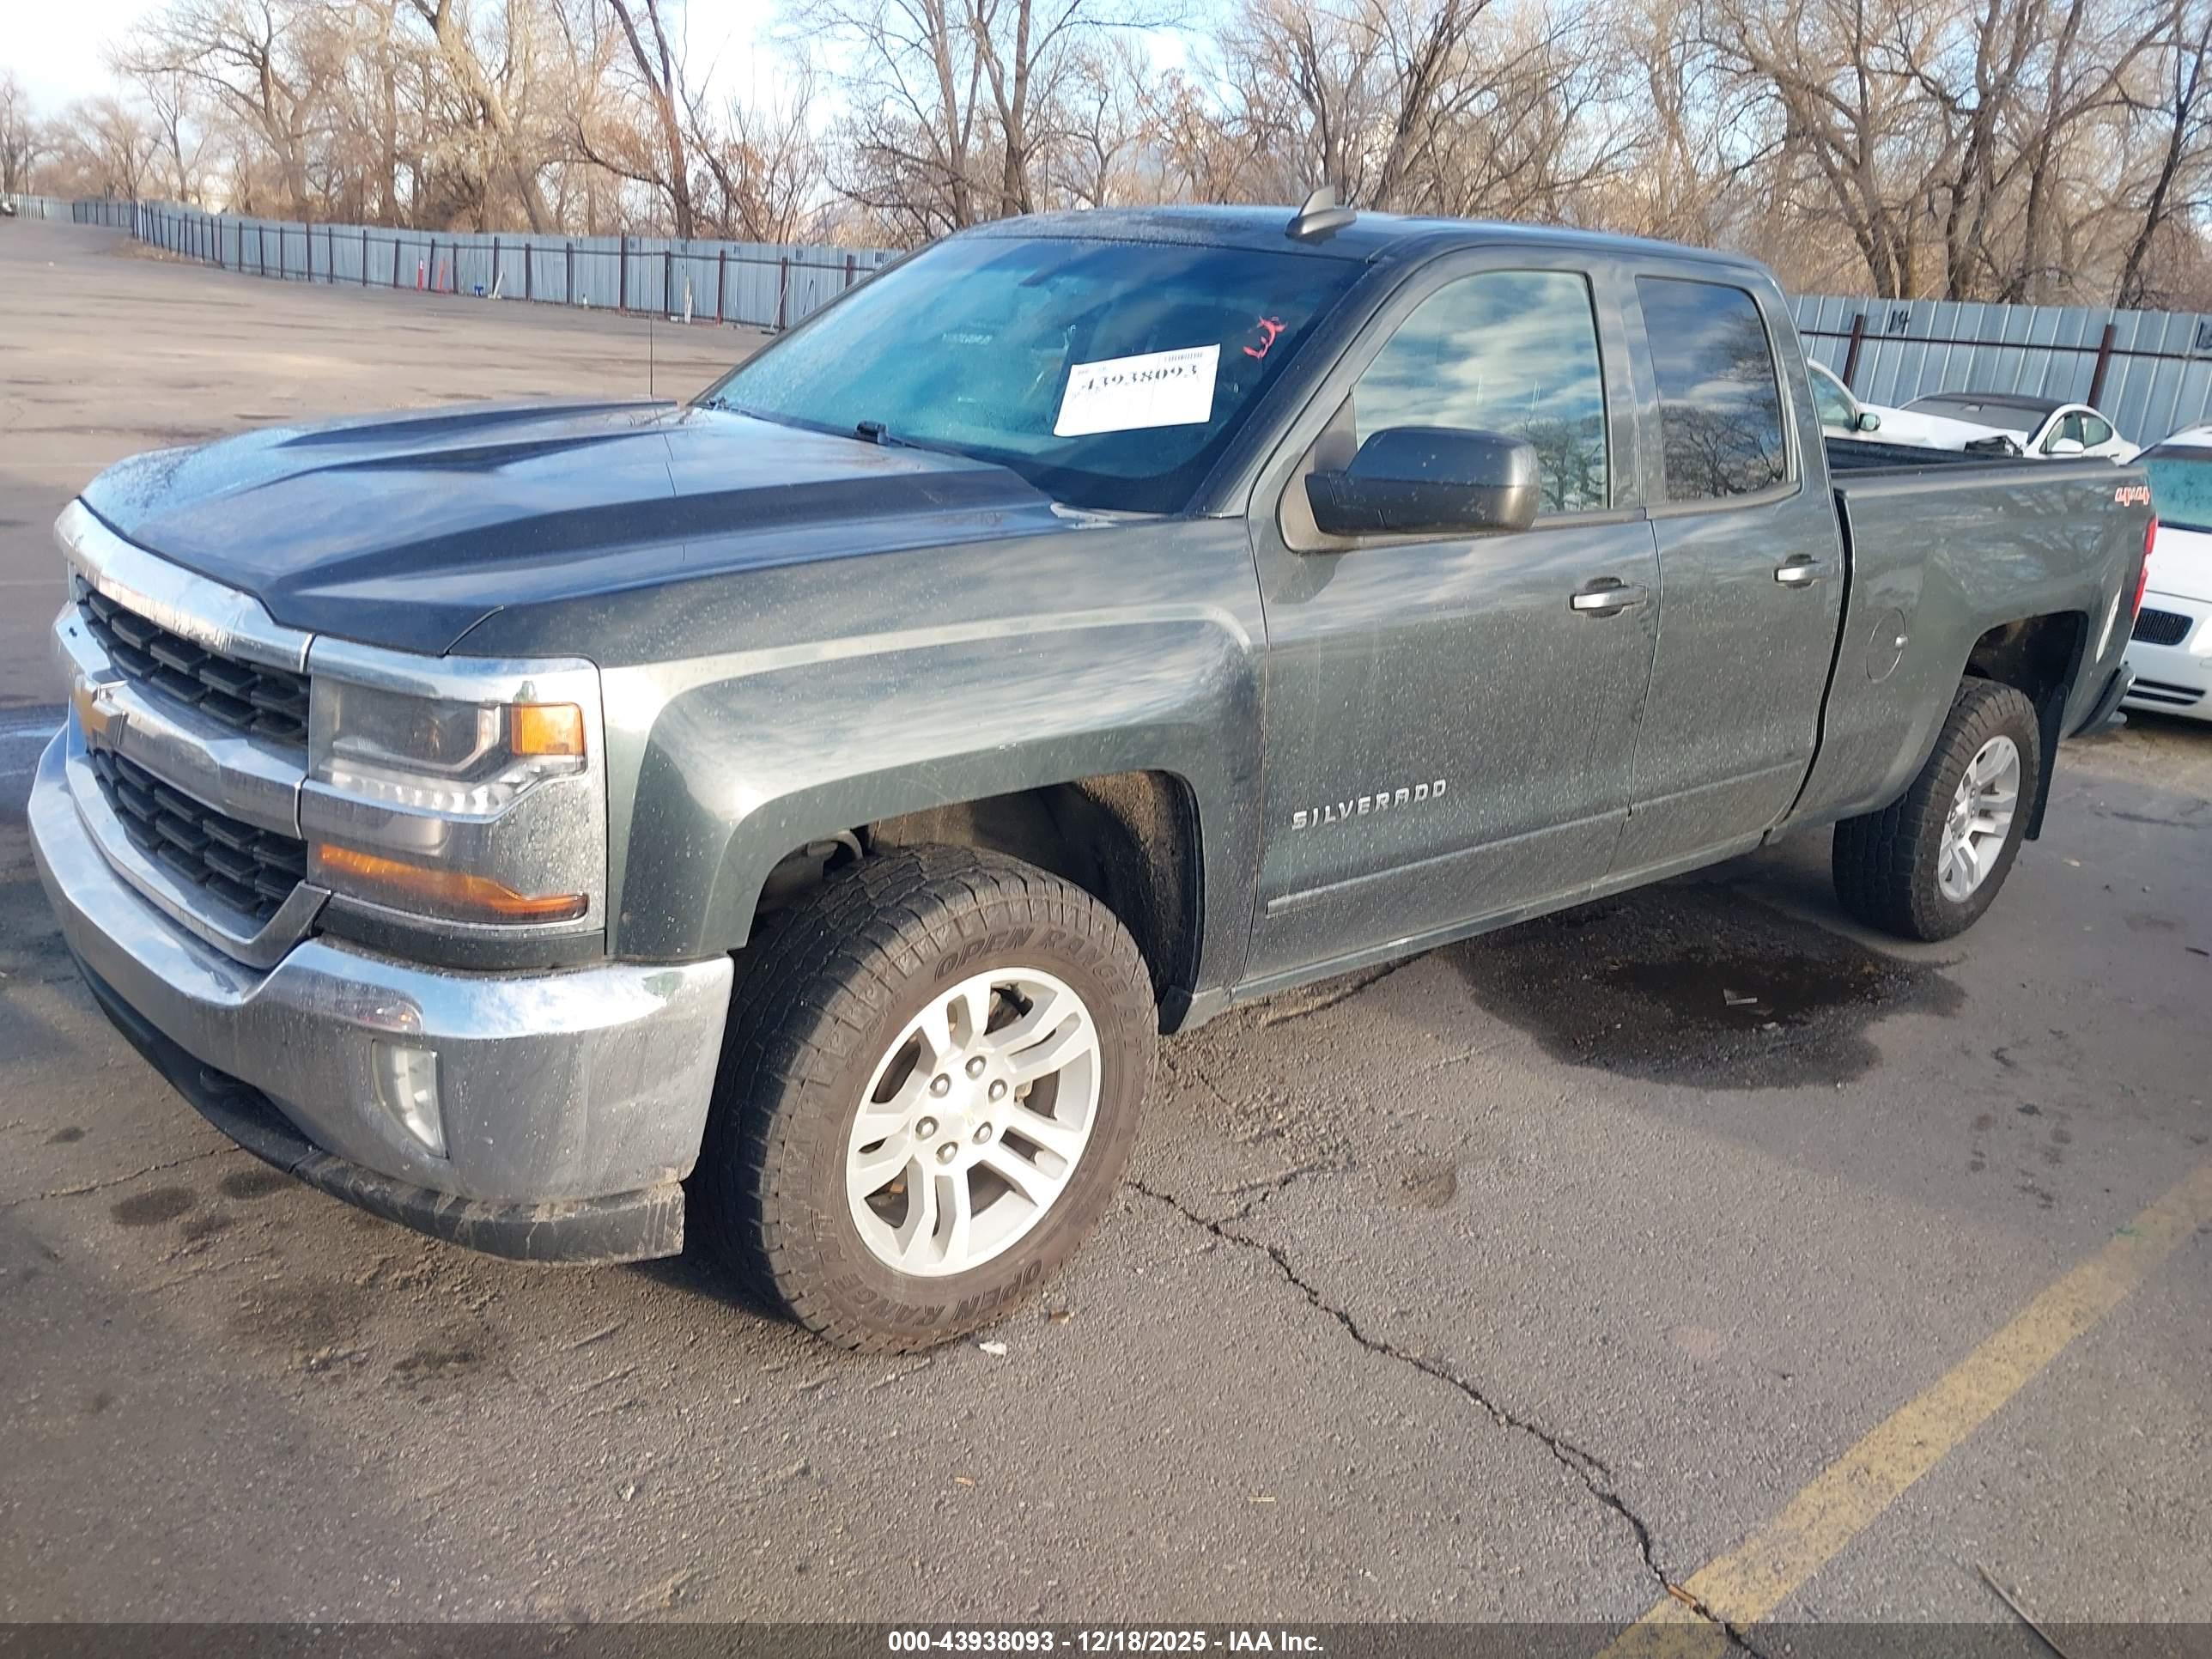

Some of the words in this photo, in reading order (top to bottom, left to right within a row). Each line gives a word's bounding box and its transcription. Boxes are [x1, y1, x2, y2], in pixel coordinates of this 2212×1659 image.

[1082, 365, 1197, 390] 43938093
[1291, 779, 1447, 830] SILVERADO
[934, 927, 1035, 982] OPEN
[1036, 925, 1130, 996] RANGE
[953, 1260, 1042, 1319] OPEN
